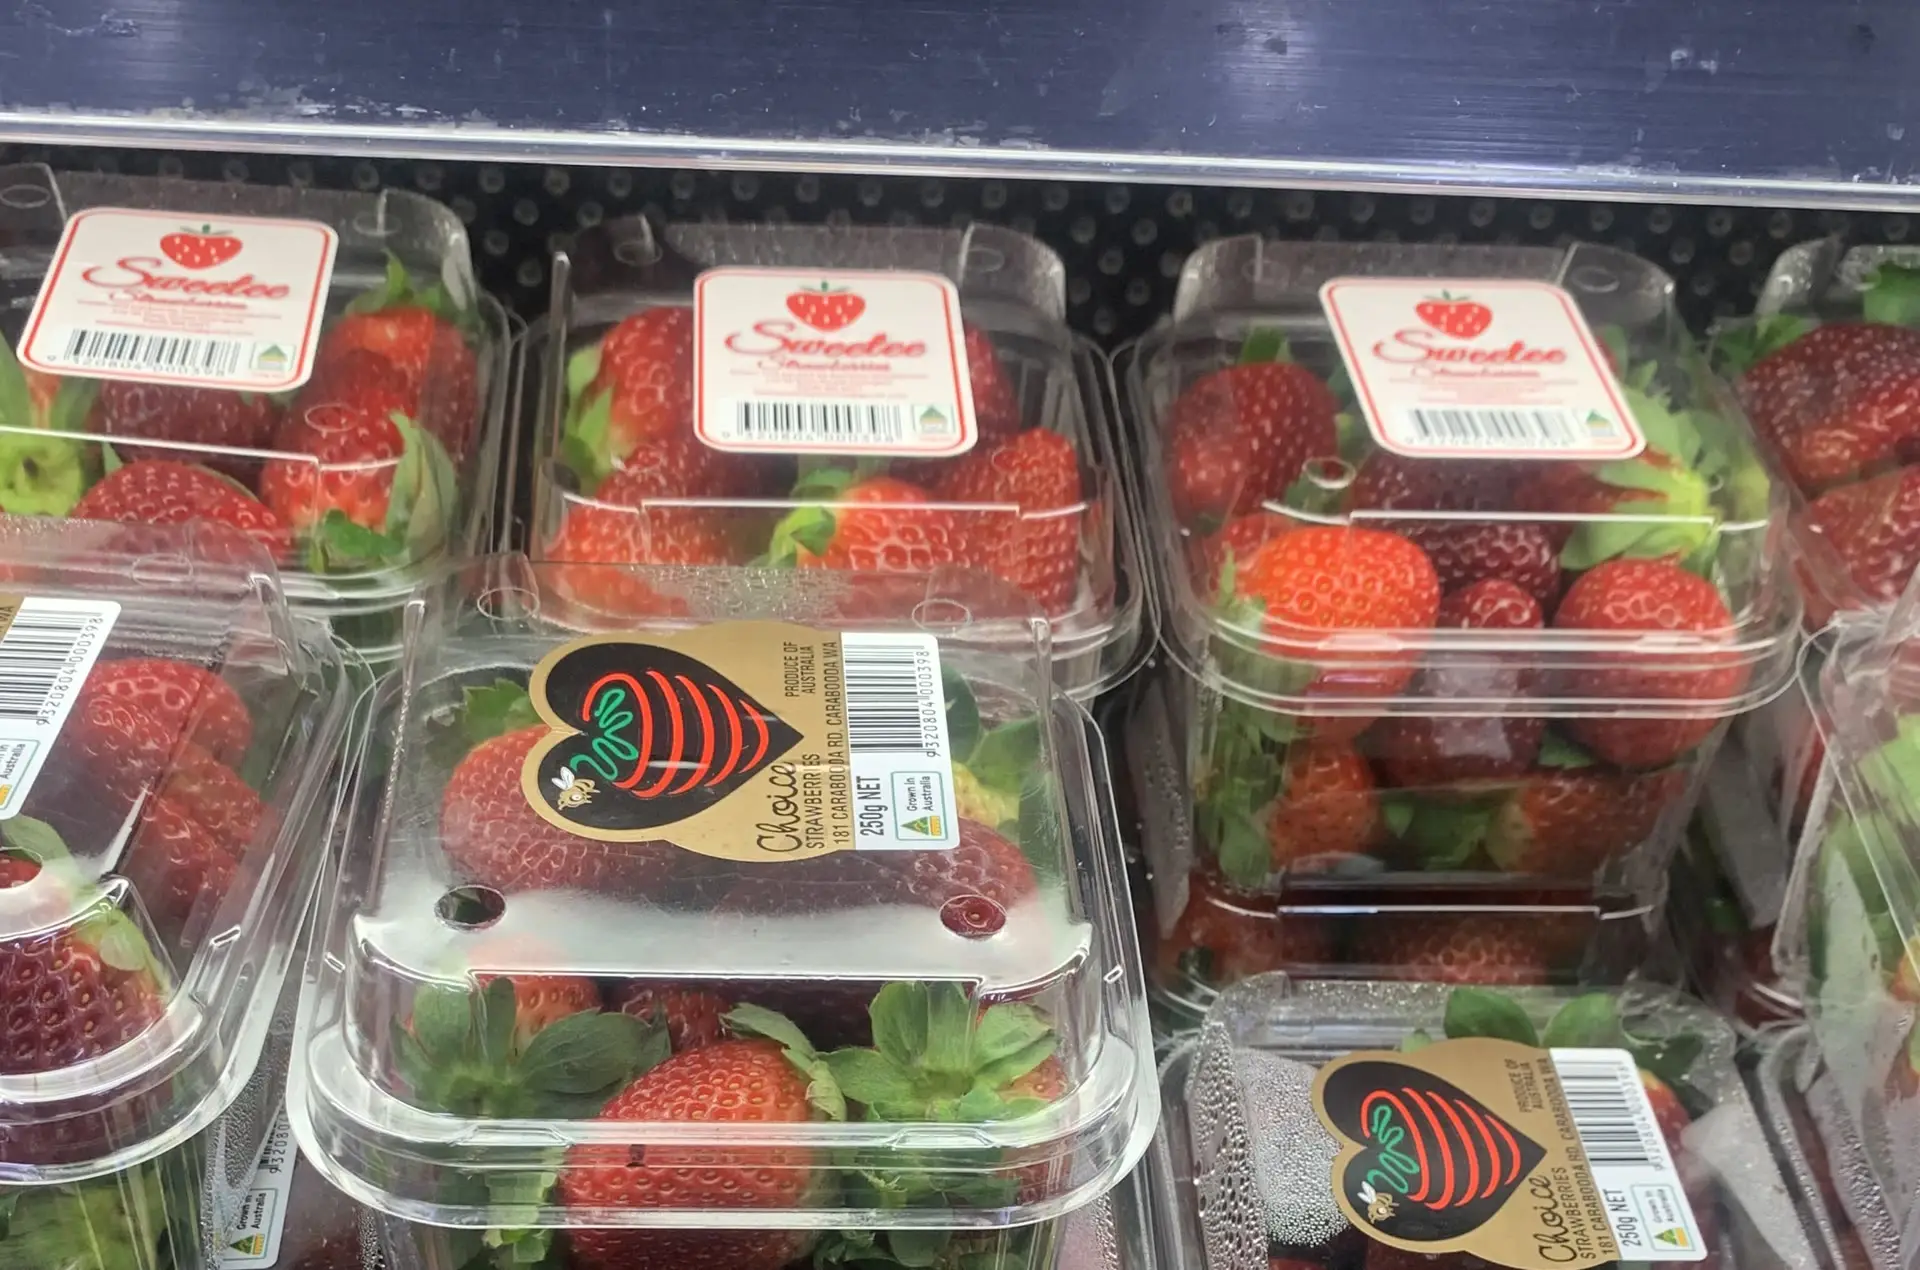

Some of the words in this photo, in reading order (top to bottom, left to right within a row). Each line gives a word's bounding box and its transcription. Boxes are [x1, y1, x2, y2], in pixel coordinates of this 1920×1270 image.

[81, 256, 290, 298] Sweetee
[724, 320, 927, 358] Sweetee
[1372, 328, 1567, 364] Sweetee
[783, 641, 798, 653] OF
[822, 641, 840, 658] WA
[784, 655, 800, 697] PRODUCE
[800, 645, 816, 694] AUSTRALIA
[823, 661, 842, 726] CARABOODA
[802, 753, 825, 849] STRAWBERRIES
[828, 751, 848, 820] CARABOODA
[856, 775, 882, 800] NET
[907, 786, 918, 812] Grown
[919, 775, 934, 811] Australia
[755, 761, 803, 852] Choice
[860, 804, 888, 836] 250g
[832, 824, 850, 844] 181
[1504, 1059, 1519, 1069] OF
[1508, 1073, 1532, 1112] PRODUCE
[1520, 1062, 1544, 1109] AUSTRALIA
[1543, 1078, 1574, 1140] CARABOODA
[236, 1201, 251, 1230] Grown
[251, 1193, 267, 1229] Australia
[1551, 1167, 1596, 1259] STRAWBERRIES
[1572, 1164, 1607, 1231] CARABOODA
[1603, 1188, 1630, 1212] NET
[1528, 1174, 1577, 1262] Choice
[1616, 1217, 1642, 1246] 250g
[1596, 1235, 1615, 1255] 181
